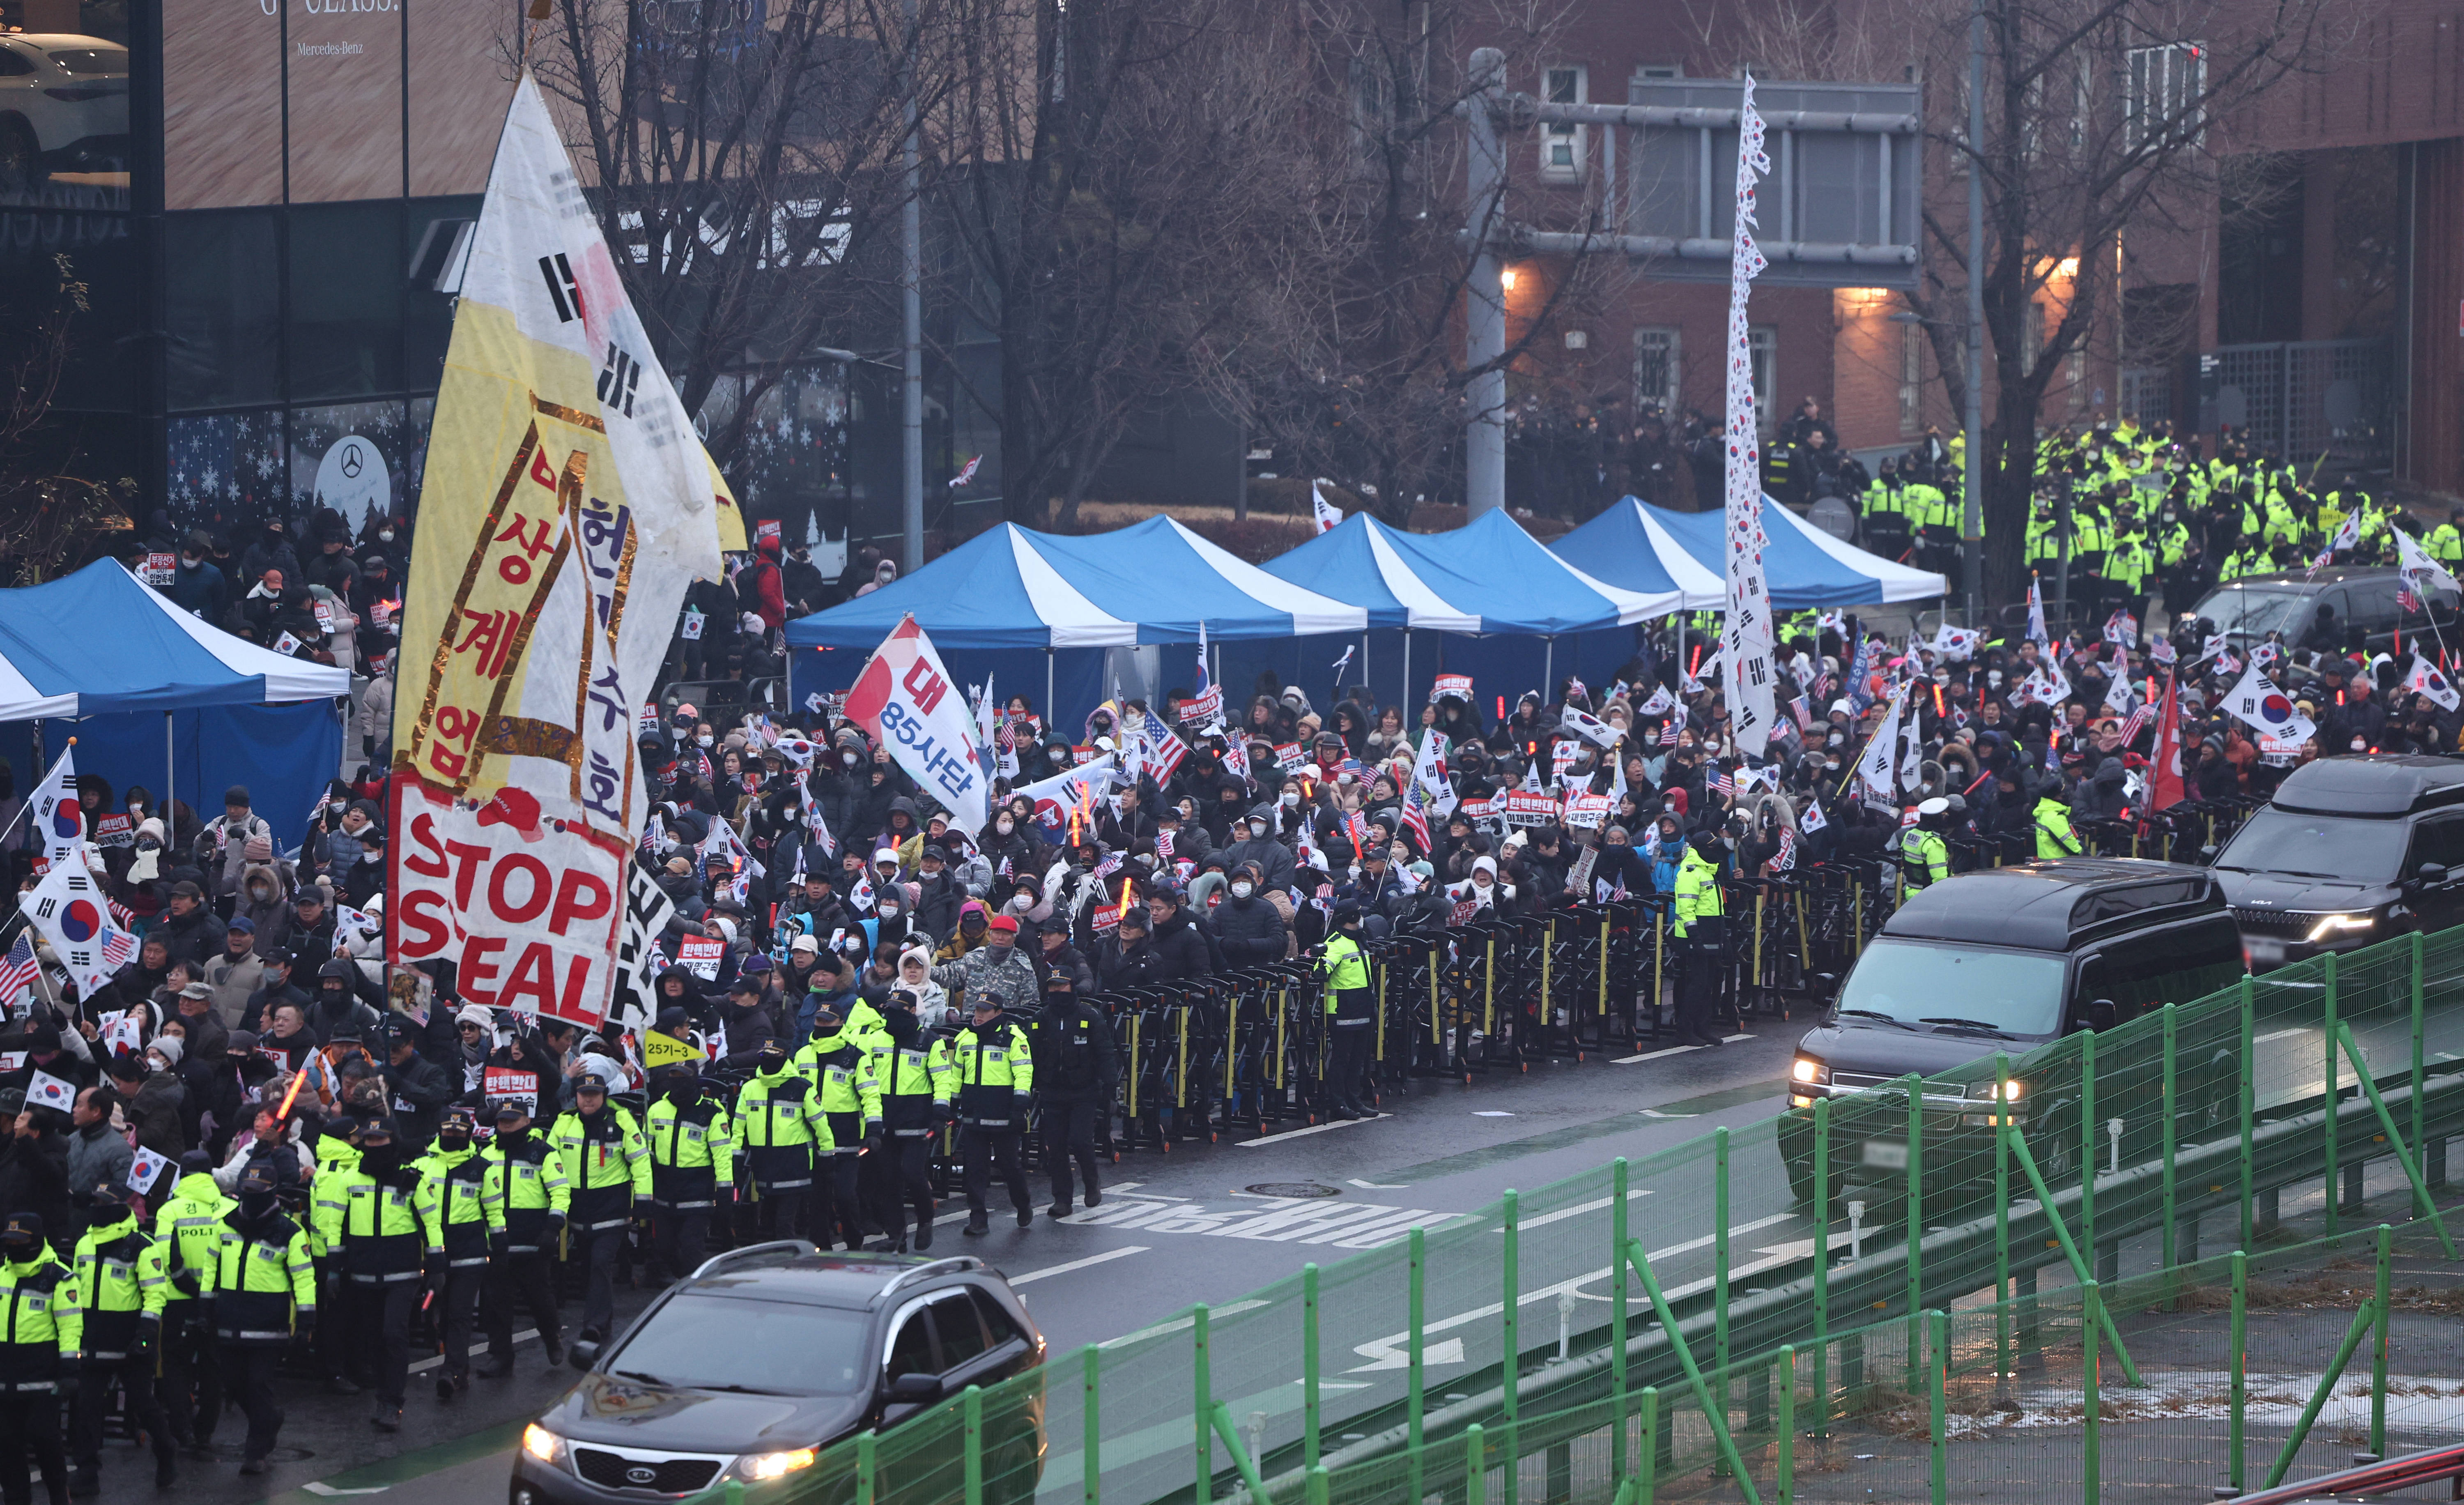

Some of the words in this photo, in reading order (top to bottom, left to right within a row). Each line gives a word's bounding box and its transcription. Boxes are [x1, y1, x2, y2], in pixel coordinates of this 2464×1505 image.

[297, 41, 363, 56] Mercedes-Benz
[151, 555, 175, 566] 부정선거
[149, 573, 174, 584] 입법독재
[581, 498, 630, 822] 헌수호
[1434, 678, 1470, 688] 탄핵반대
[1181, 696, 1218, 719] 탄핵반대
[880, 702, 972, 798] 85사단
[493, 795, 511, 815] MAGA
[1461, 802, 1492, 816] 탄핵반
[1509, 797, 1556, 812] 탄핵반대
[1582, 847, 1595, 863] STOP
[404, 812, 611, 937] STOP
[1578, 862, 1589, 876] THE
[1453, 902, 1478, 914] TOP
[683, 942, 723, 957] 탄핵반대
[399, 890, 603, 1026] SEAL
[648, 1044, 688, 1058] 25기-3
[486, 1075, 537, 1092] 탄핵반대
[181, 1228, 214, 1237] POLI
